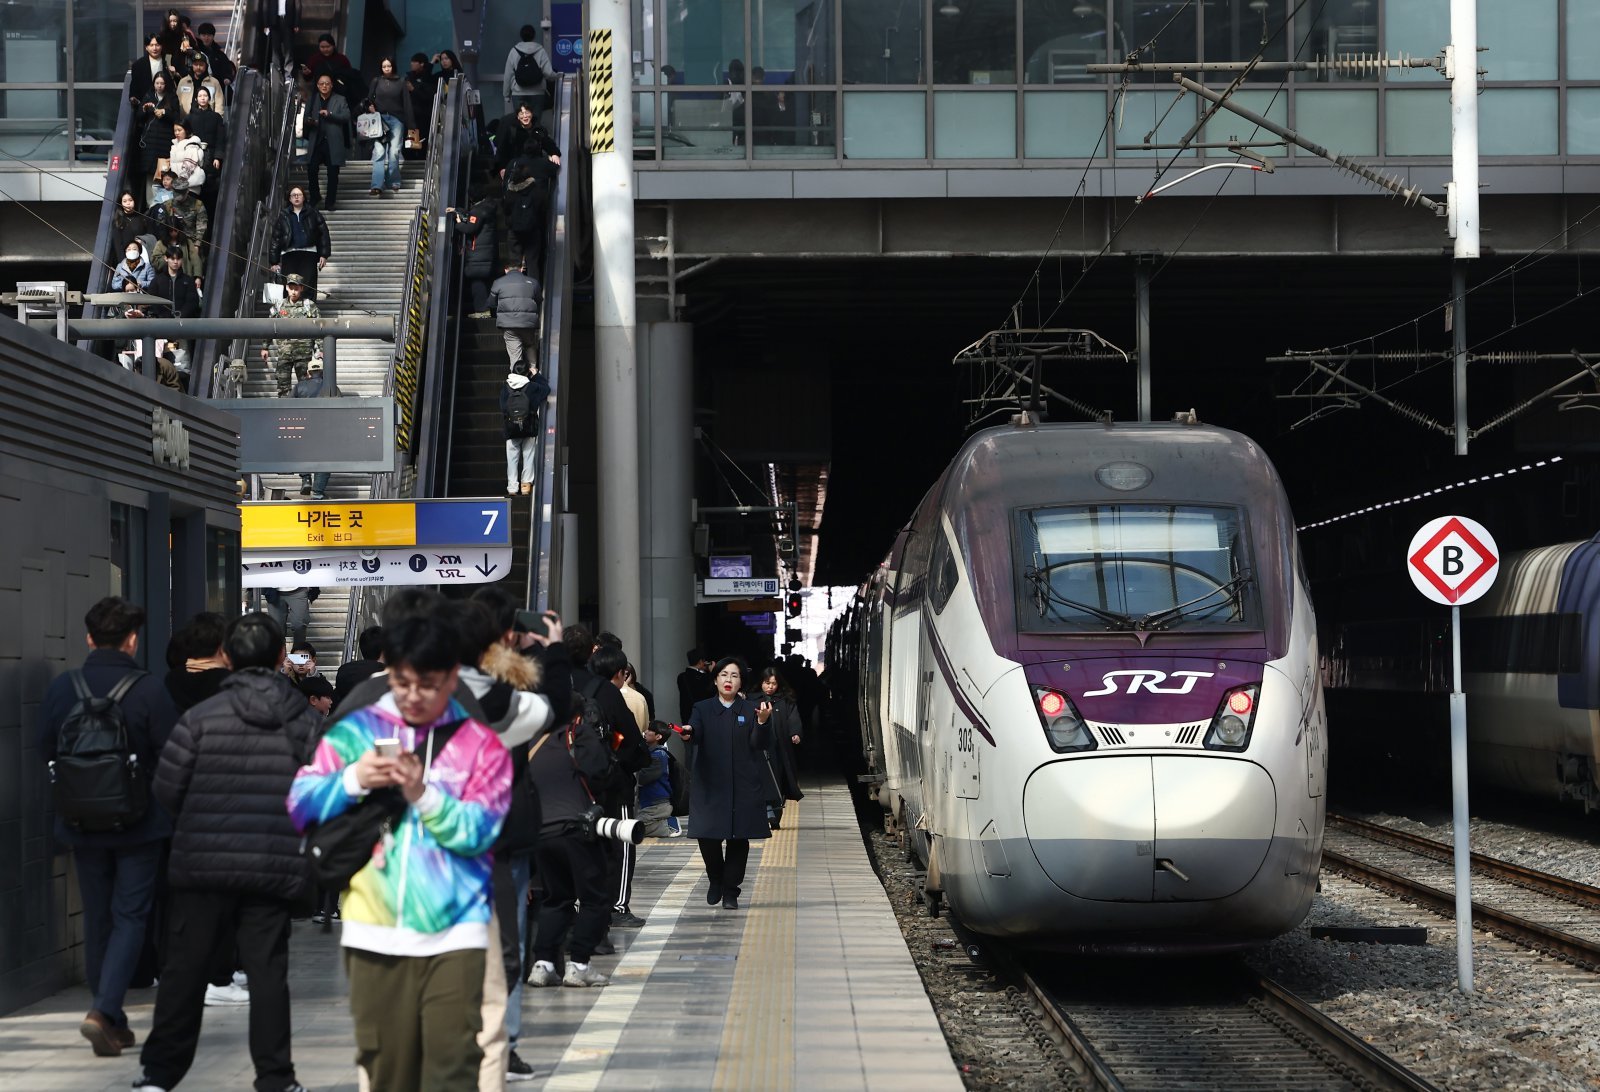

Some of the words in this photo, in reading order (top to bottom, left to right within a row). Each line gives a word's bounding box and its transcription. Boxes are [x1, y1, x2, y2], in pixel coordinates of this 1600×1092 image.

[297, 510, 341, 528] 나가는
[348, 510, 363, 528] 곳
[481, 510, 499, 536] 7
[307, 533, 325, 542] Exit
[333, 532, 353, 542] 出口
[1442, 545, 1464, 576] B
[1083, 669, 1215, 697] SRT
[958, 727, 973, 752] 303
